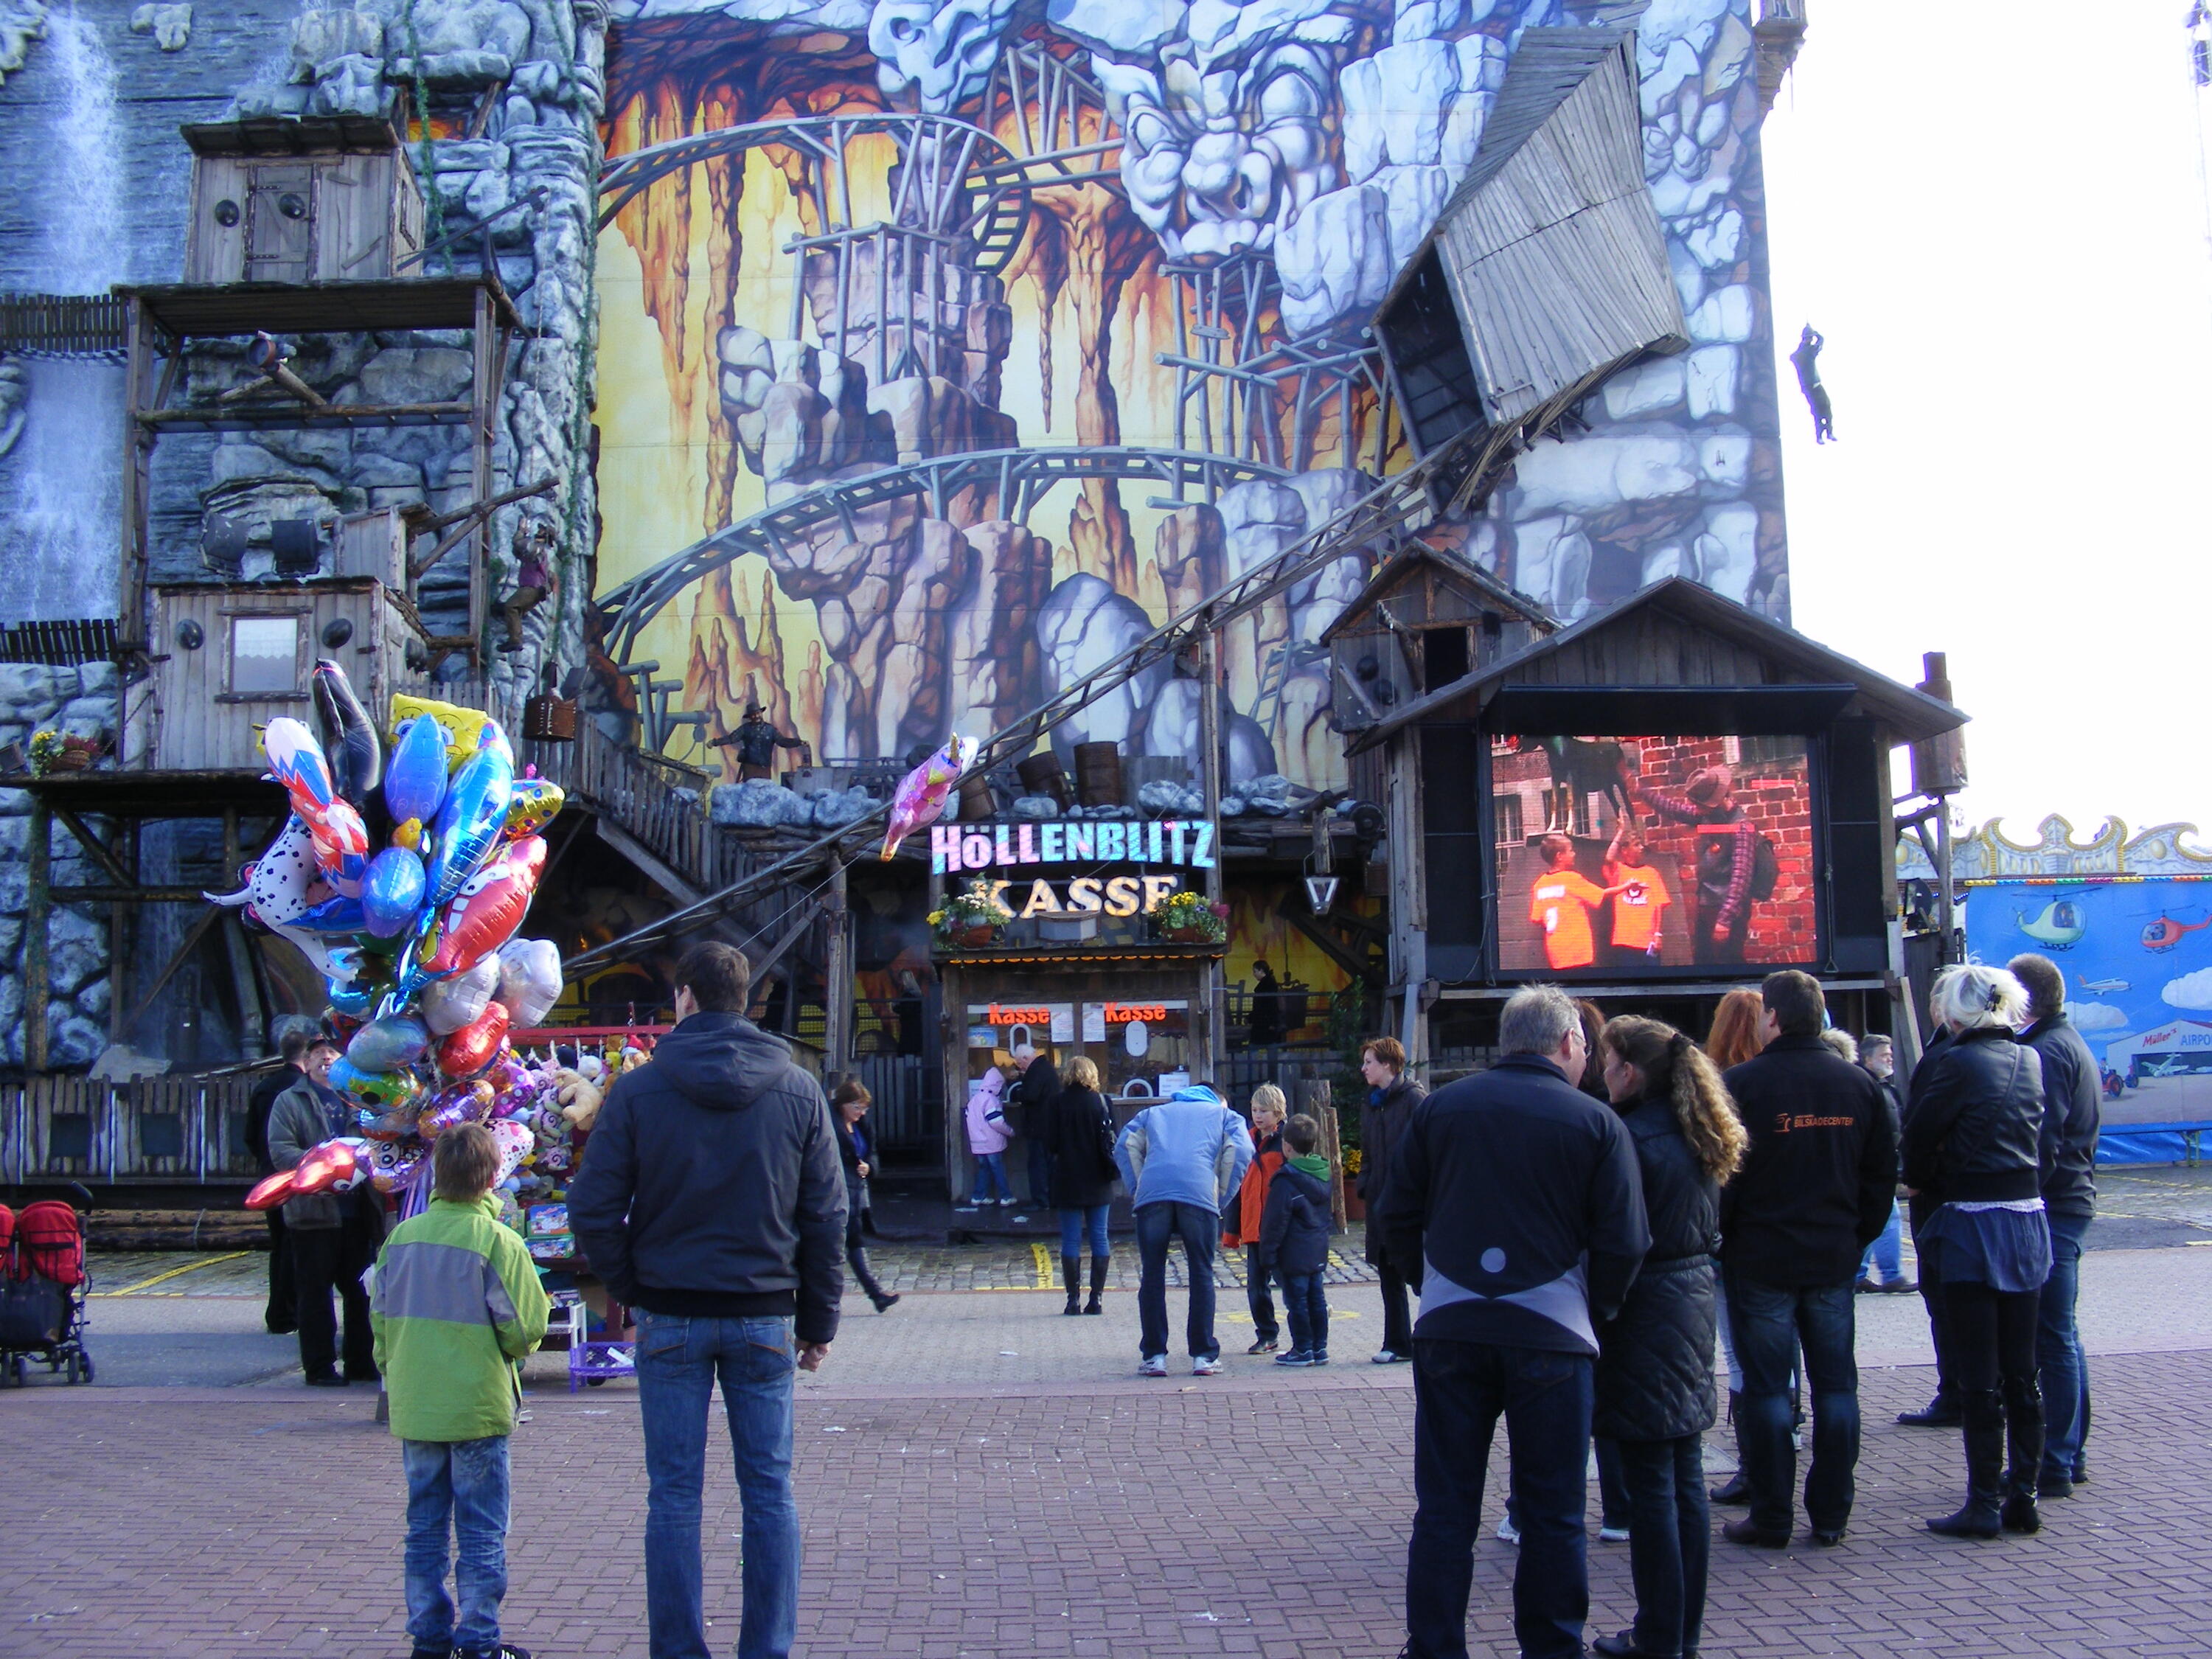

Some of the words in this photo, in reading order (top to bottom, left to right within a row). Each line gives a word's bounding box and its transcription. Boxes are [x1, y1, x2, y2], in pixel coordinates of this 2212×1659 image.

[988, 1004, 1051, 1025] Kasse
[1105, 1001, 1166, 1023] Kasse
[2180, 1033, 2212, 1046] AIRPO
[1793, 1116, 1854, 1128] BILSKADECENTER
